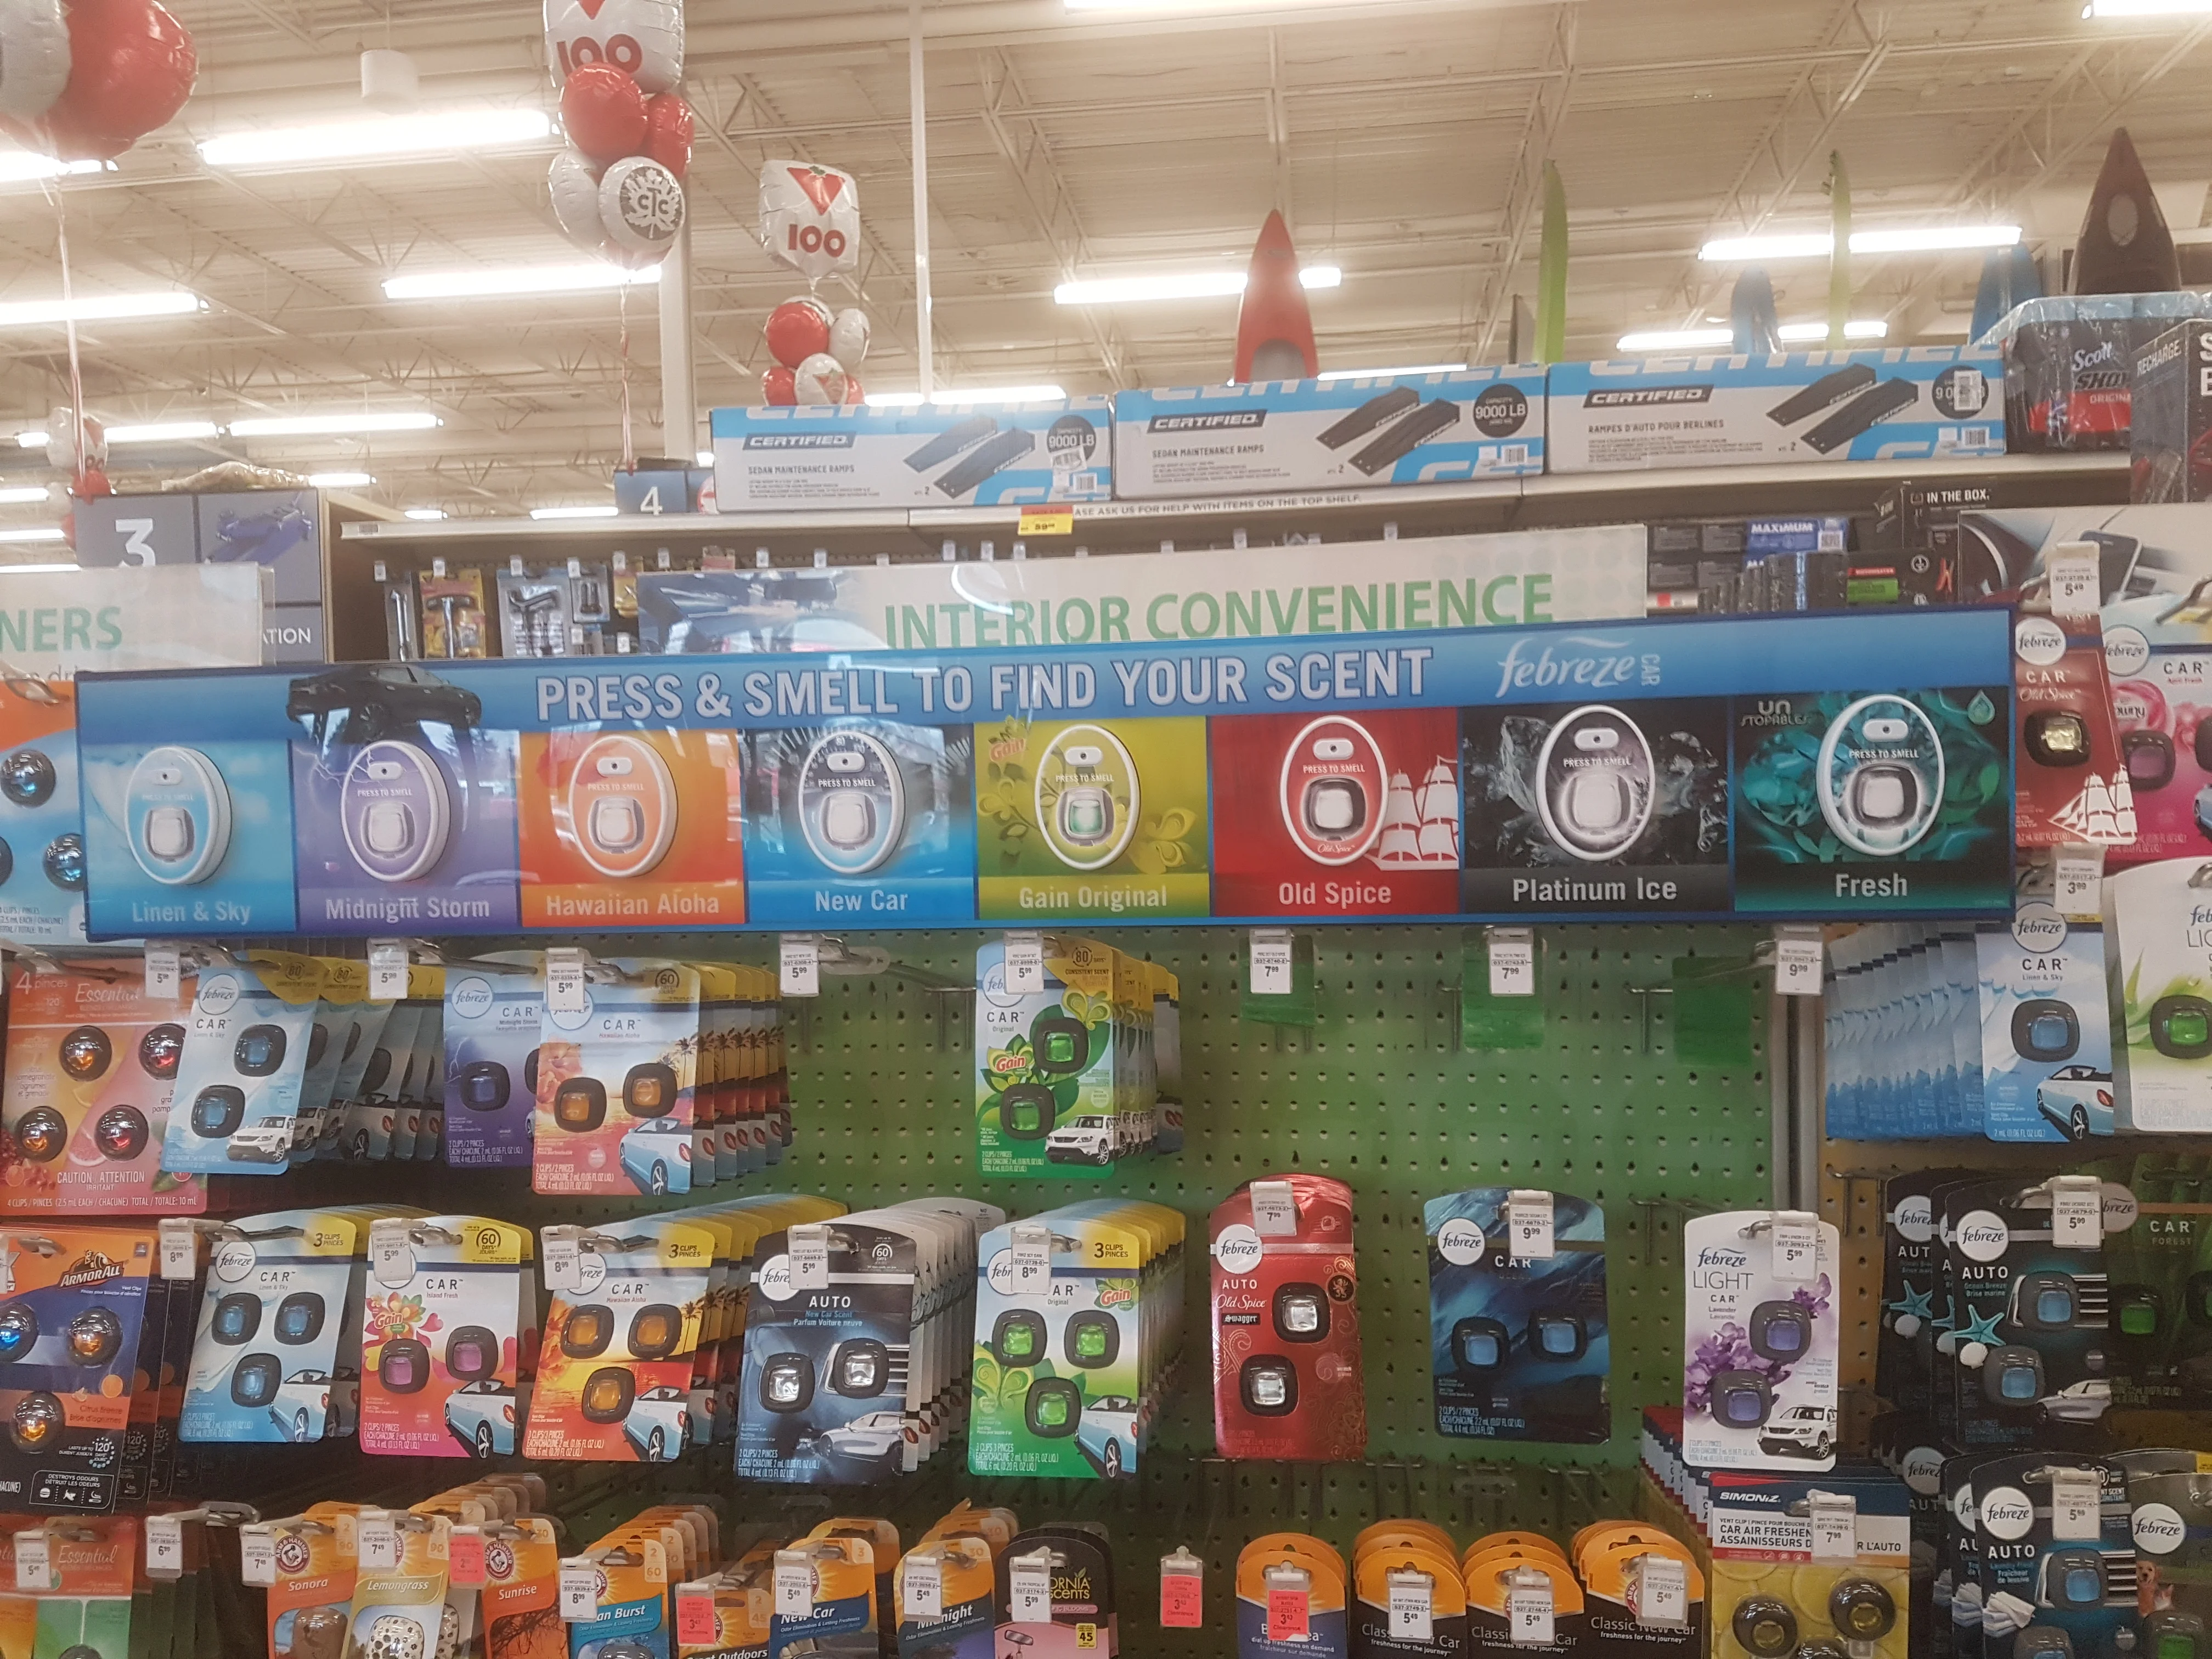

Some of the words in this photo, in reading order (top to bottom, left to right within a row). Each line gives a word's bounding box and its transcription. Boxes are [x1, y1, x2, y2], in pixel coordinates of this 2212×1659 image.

[557, 34, 642, 76] 100
[788, 224, 846, 257] 100
[2072, 341, 2113, 371] Scott
[2137, 340, 2182, 379] RECHARGE
[1591, 389, 1705, 405] CERTIFIED
[1475, 405, 1504, 420] 9000
[1506, 404, 1525, 417] LB
[1154, 415, 1259, 430] CERTIFIED
[1588, 424, 1622, 433] RAMPES
[1625, 422, 1654, 432] D'AUTO
[1657, 421, 1680, 431] POUR
[1683, 419, 1724, 430] BERLINES
[748, 435, 849, 448] CERTIFIED
[1152, 448, 1178, 458] SEDAN
[1180, 446, 1235, 457] MAINTENANCE
[1237, 444, 1264, 454] RAMPS
[747, 465, 773, 475] SEDAN
[774, 464, 827, 475] MAINTENANCE
[829, 464, 855, 473] RAMPS
[640, 486, 662, 516] 4
[1927, 492, 1937, 502] IN
[1938, 490, 1961, 501] THE
[1097, 507, 1119, 516] ASK
[1121, 506, 1136, 515] US
[1138, 505, 1160, 514] FOR
[1163, 504, 1189, 513] HELP
[1192, 503, 1221, 511] WITH
[1223, 501, 1254, 510] ITEMS
[1257, 499, 1274, 508] ON
[1278, 498, 1299, 507] THE
[1302, 496, 1323, 506] TOP
[1751, 522, 1814, 533] MAXIMUM
[115, 518, 156, 567] 3
[885, 597, 1131, 650] INTERIOR
[1147, 574, 1554, 641] CONVENIENCE
[2019, 633, 2062, 651] febreze
[2163, 661, 2203, 675] CAR
[536, 672, 684, 721] PRESS
[695, 672, 733, 719] &
[743, 667, 899, 717] SMELL
[913, 666, 974, 714] TO
[991, 662, 1097, 712] FIND
[1112, 656, 1250, 707] YOUR
[1265, 648, 1434, 702] SCENT
[1494, 636, 1637, 699] febreze
[1640, 654, 1660, 687] CAR
[2025, 671, 2067, 684] CAR
[818, 778, 840, 787] PRESS
[842, 778, 851, 787] TO
[853, 778, 876, 787] SMELL
[1513, 878, 1626, 902] Platinum
[1635, 877, 1677, 901] Ice
[1835, 873, 1908, 898] Fresh
[815, 890, 863, 912] New
[870, 889, 909, 911] Car
[1019, 887, 1070, 909] Gain
[1077, 884, 1167, 912] Original
[1278, 883, 1317, 906] Old
[1324, 882, 1392, 905] Spice
[325, 898, 419, 924] Midnight
[427, 897, 490, 918] Storm
[546, 894, 648, 916] Hawaiian
[658, 893, 720, 914] Aloha
[132, 900, 187, 923] Linen
[191, 901, 210, 922] &
[215, 901, 251, 926] Sky
[2017, 918, 2062, 936] febreze
[1076, 951, 1088, 962] 80
[2023, 958, 2062, 971] CAR
[15, 972, 32, 995] 4
[659, 973, 675, 986] 60
[201, 988, 235, 1001] febreze
[456, 990, 490, 1005] febreze
[503, 1007, 533, 1018] CAR
[986, 1012, 1019, 1023] CAR
[196, 1019, 226, 1030] CAR
[603, 1019, 636, 1031] CAR
[996, 1055, 1026, 1073] Gain
[57, 1172, 93, 1184] CAUTION
[99, 1171, 145, 1183] ATTENTION
[2150, 1221, 2190, 1233] CAR
[481, 1234, 496, 1245] 60
[1442, 1232, 1482, 1249] febreze
[1962, 1226, 2005, 1244] febreze
[668, 1244, 678, 1259] 3
[679, 1244, 698, 1253] CLIPS
[1093, 1242, 1104, 1258] 3
[1105, 1243, 1124, 1251] CLIPS
[1220, 1239, 1258, 1256] febreze
[219, 1255, 252, 1268] febreze
[1494, 1255, 1533, 1269] CAR
[1697, 1246, 1747, 1267] febreze
[261, 1272, 291, 1282] CAR
[1962, 1266, 2008, 1280] AUTO
[426, 1279, 458, 1290] CAR
[1222, 1279, 1257, 1289] AUTO
[1692, 1272, 1754, 1290] LIGHT
[612, 1283, 644, 1295] CAR
[809, 1295, 851, 1308] AUTO
[1100, 1288, 1131, 1306] Gain
[1711, 1294, 1736, 1304] CAR
[374, 1313, 404, 1329] Gain
[1223, 1314, 1257, 1324] Swagger
[1987, 1503, 2029, 1523] febreze
[2135, 1519, 2181, 1536] febreze
[1720, 1536, 1802, 1548] ASSAINISSEURS
[1866, 1541, 1901, 1551] L'AUTO
[1988, 1544, 2035, 1559] AUTO
[288, 1578, 329, 1592] Sonora
[366, 1578, 428, 1592] Lemongrass
[498, 1584, 537, 1600] Sunrise
[614, 1605, 646, 1619] Burst
[1079, 1632, 1093, 1641] 45
[1439, 1636, 1460, 1649] Car
[1600, 1630, 1633, 1640] freshness
[1657, 1635, 1681, 1644] journey
